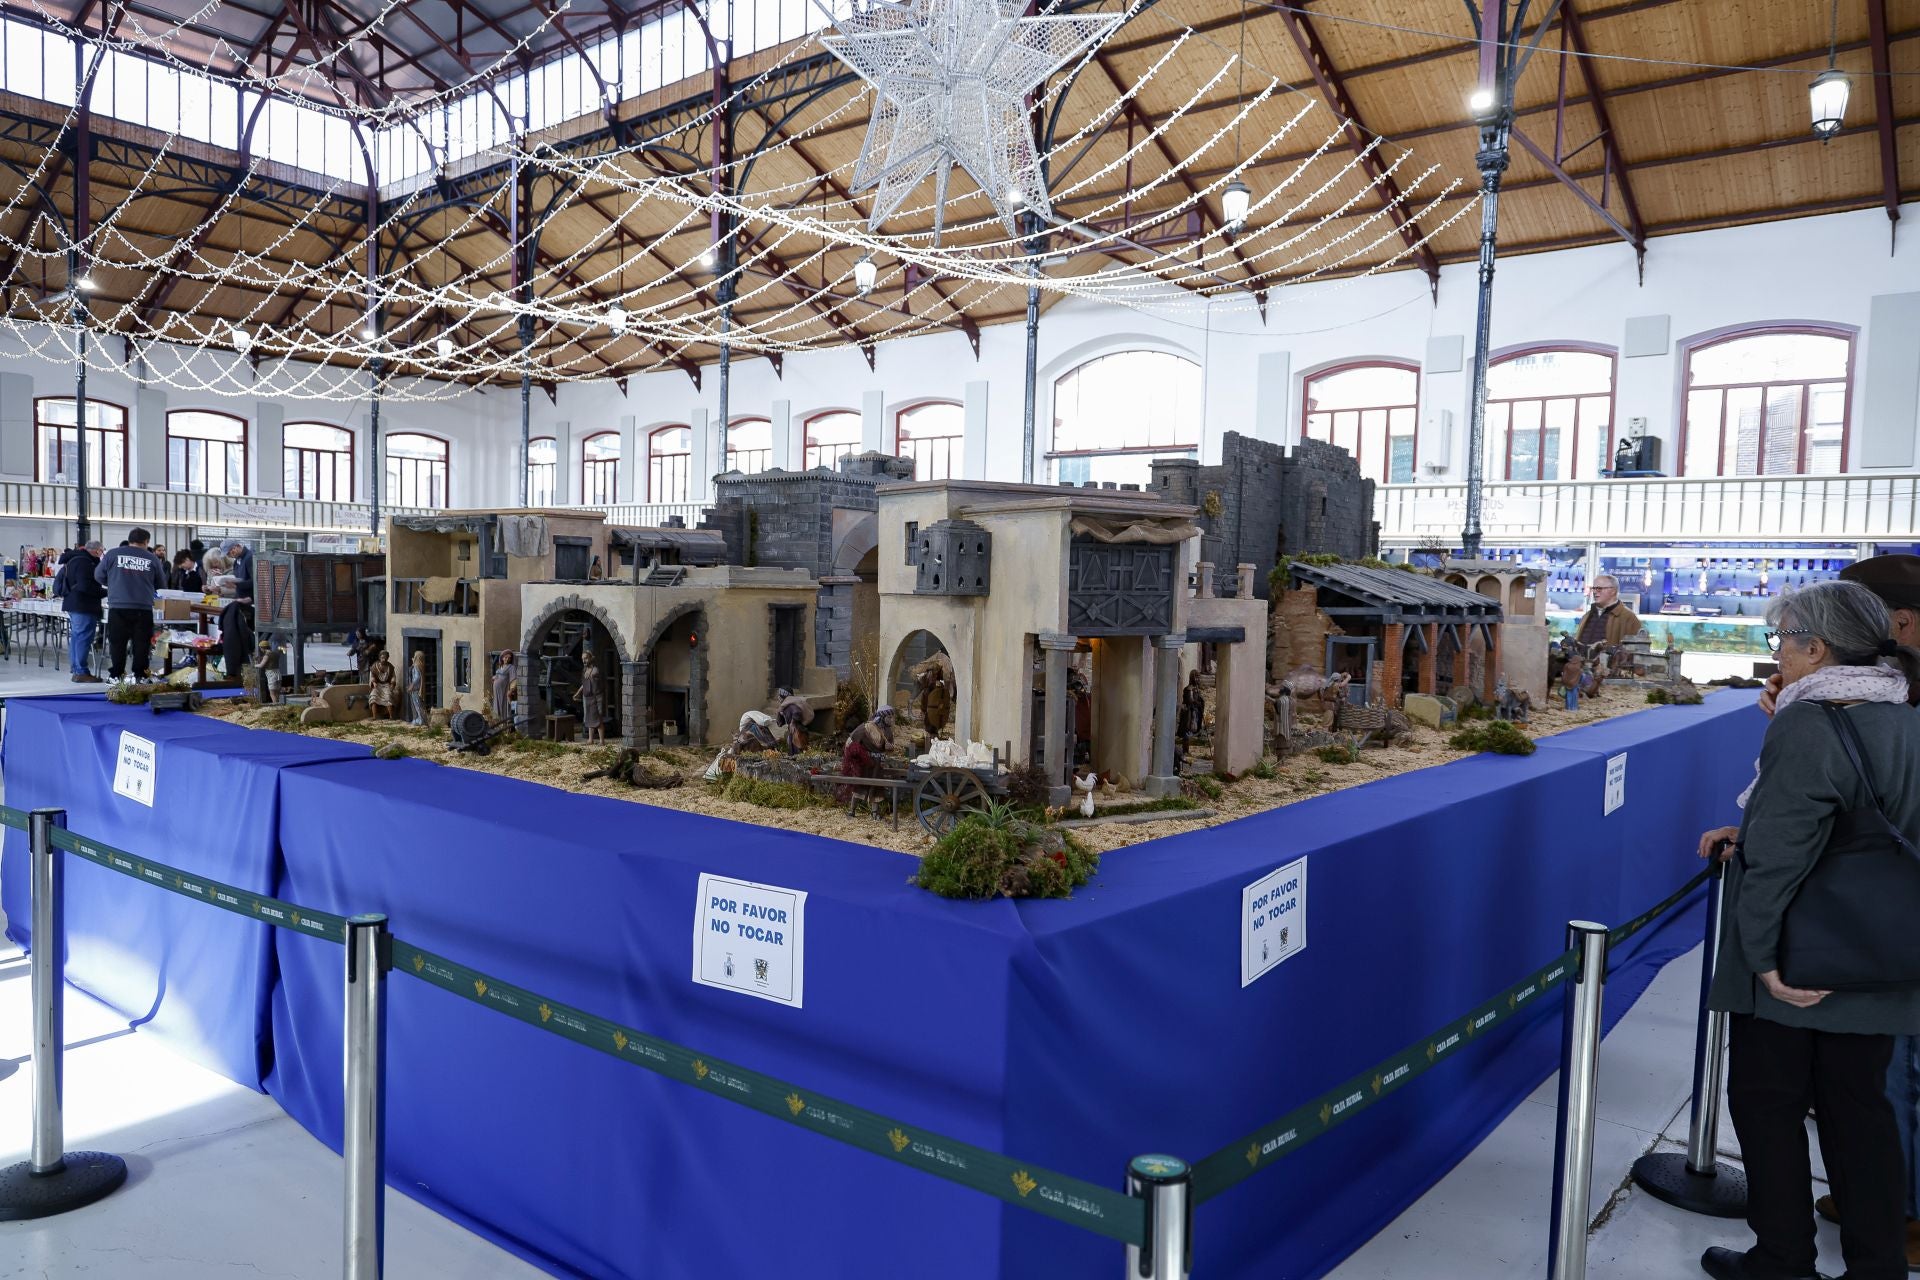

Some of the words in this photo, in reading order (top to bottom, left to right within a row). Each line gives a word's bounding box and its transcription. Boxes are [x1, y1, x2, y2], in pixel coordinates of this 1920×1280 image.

[1448, 500, 1504, 510] PESDOS
[117, 555, 151, 569] UPSIDE
[124, 744, 135, 754] POR
[137, 748, 151, 761] FAVOR
[123, 756, 131, 765] NO
[134, 759, 149, 773] TOCAR
[1252, 894, 1268, 913] POR
[1271, 878, 1298, 901] FAVOR
[711, 896, 737, 914] POR
[742, 902, 787, 924] FAVOR
[1253, 915, 1265, 931] NO
[1268, 898, 1297, 921] TOCAR
[711, 918, 730, 934] NO
[737, 924, 784, 946] TOCAR
[1436, 1040, 1447, 1053] CAJA
[1446, 1033, 1460, 1048] RURAL
[1383, 1071, 1395, 1085] CAJA
[1394, 1063, 1410, 1078] RURAL
[1333, 1099, 1346, 1115] CAJA
[1346, 1090, 1363, 1107] RURAL
[1262, 1138, 1277, 1155] CAJA
[1278, 1128, 1298, 1147] RURAL
